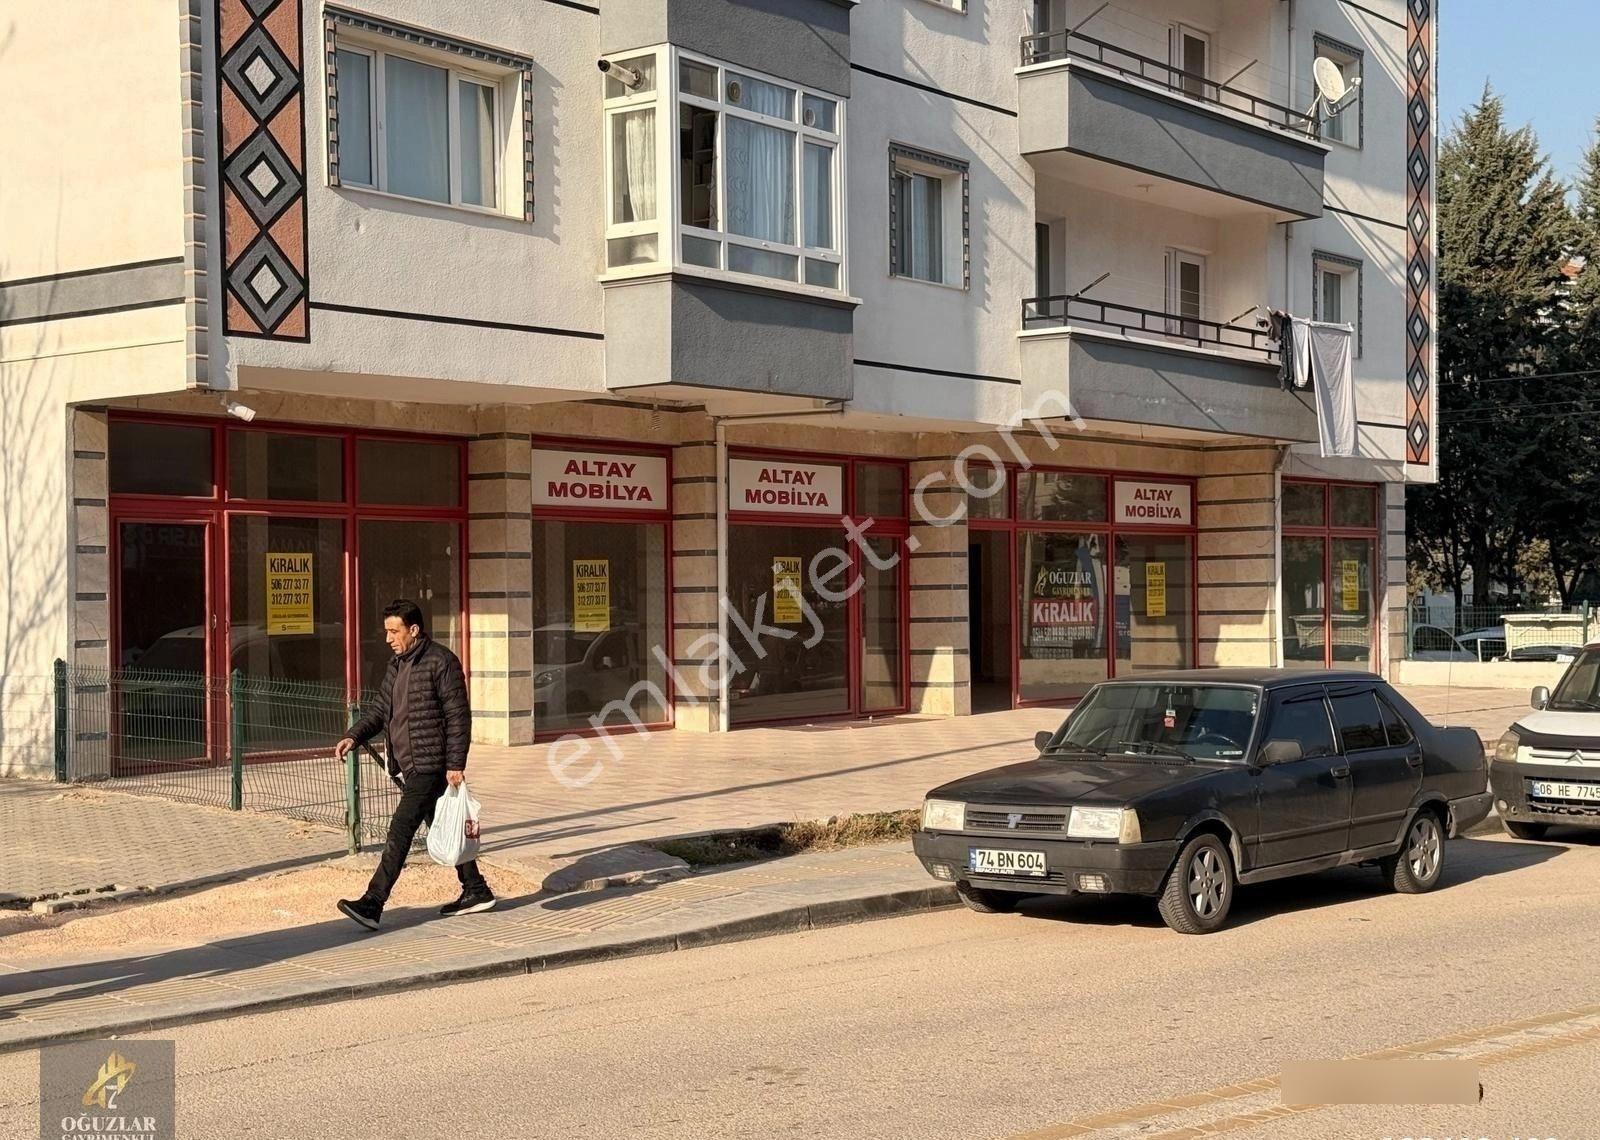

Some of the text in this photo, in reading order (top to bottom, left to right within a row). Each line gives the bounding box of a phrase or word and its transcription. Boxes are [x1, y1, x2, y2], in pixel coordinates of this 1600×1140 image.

[564, 459, 637, 478] ALTAY
[758, 468, 816, 485] ALTAY
[548, 480, 653, 501] MOBİLYA
[745, 487, 829, 507] MOBİLYA
[1134, 488, 1173, 501] ALTAY
[1125, 503, 1182, 519] MOBİLYA
[283, 578, 293, 590] 277
[294, 578, 302, 590] 33
[302, 578, 309, 590] 77
[1049, 568, 1092, 585] OĞUZLAR
[283, 593, 293, 605] 277
[294, 593, 302, 605] 33
[302, 593, 309, 605] 77
[1540, 784, 1600, 798] 06 HE 7745
[978, 851, 1043, 869] 74 BN 604
